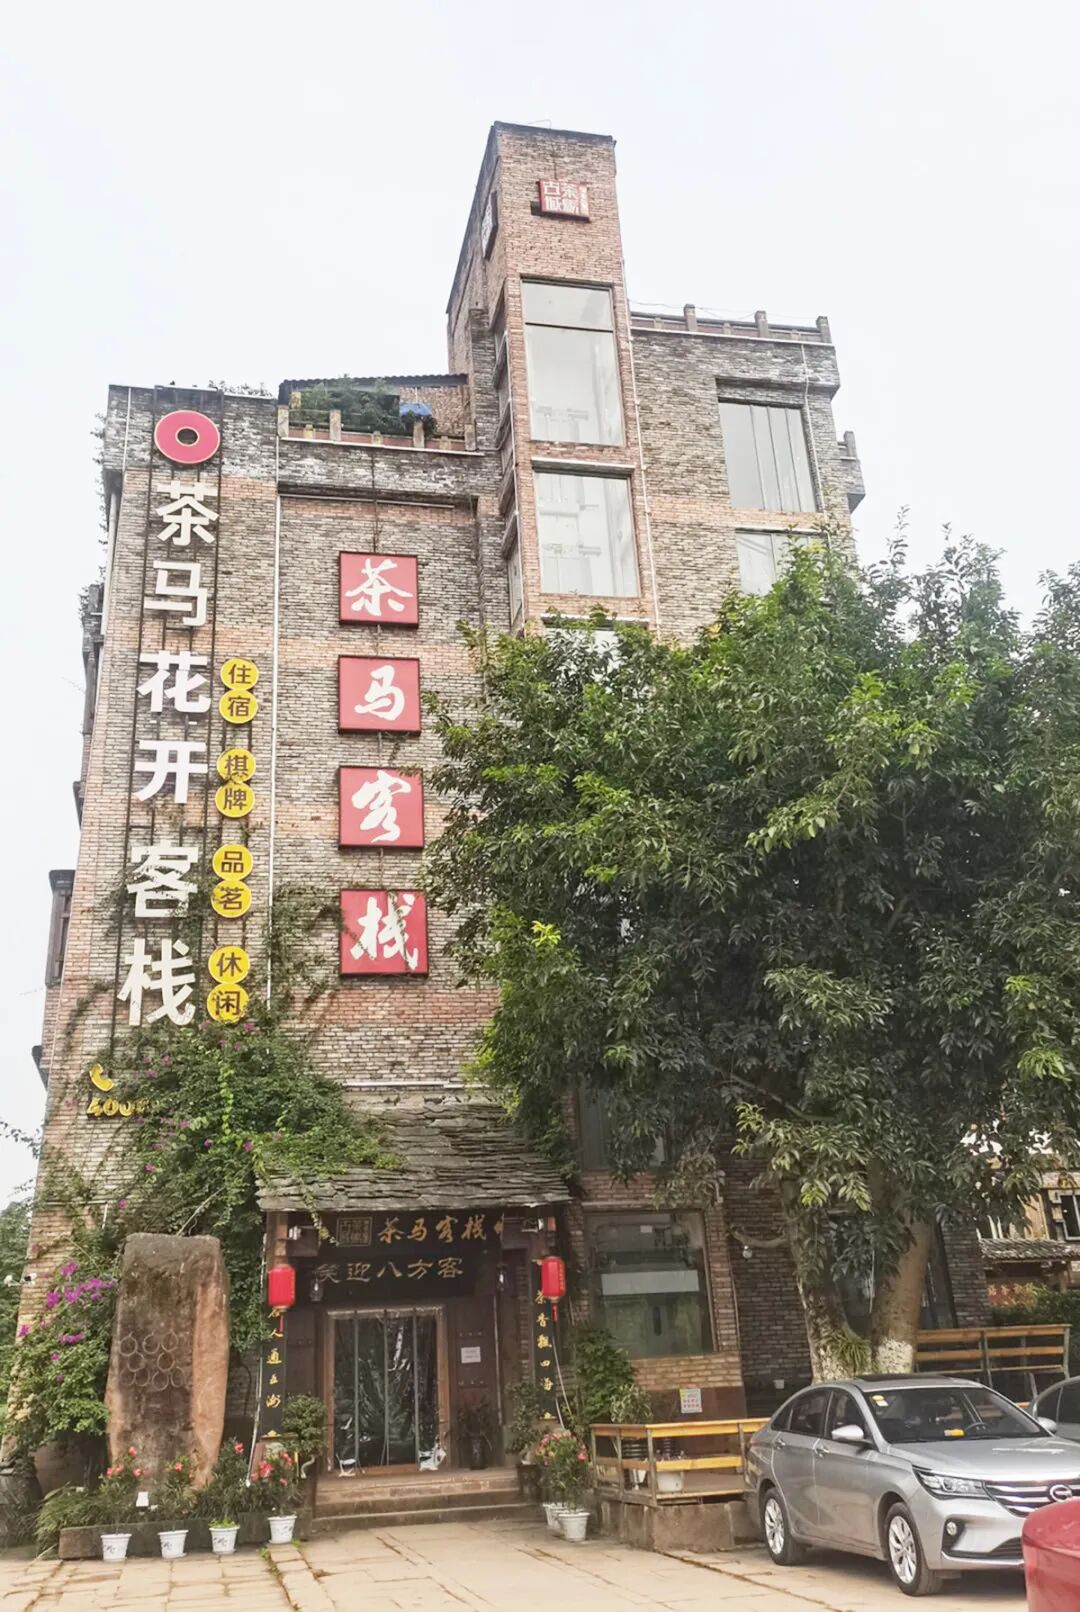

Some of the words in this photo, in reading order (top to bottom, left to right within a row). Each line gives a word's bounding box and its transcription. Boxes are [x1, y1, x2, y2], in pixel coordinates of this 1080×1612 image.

[228, 664, 252, 717] 住宿
[117, 480, 219, 1026] 茶马花开客栈
[223, 755, 249, 811] 棋牌
[219, 850, 244, 910] 品茗
[212, 951, 243, 1016] 休闲
[315, 1256, 464, 1284] 笑迎八方客
